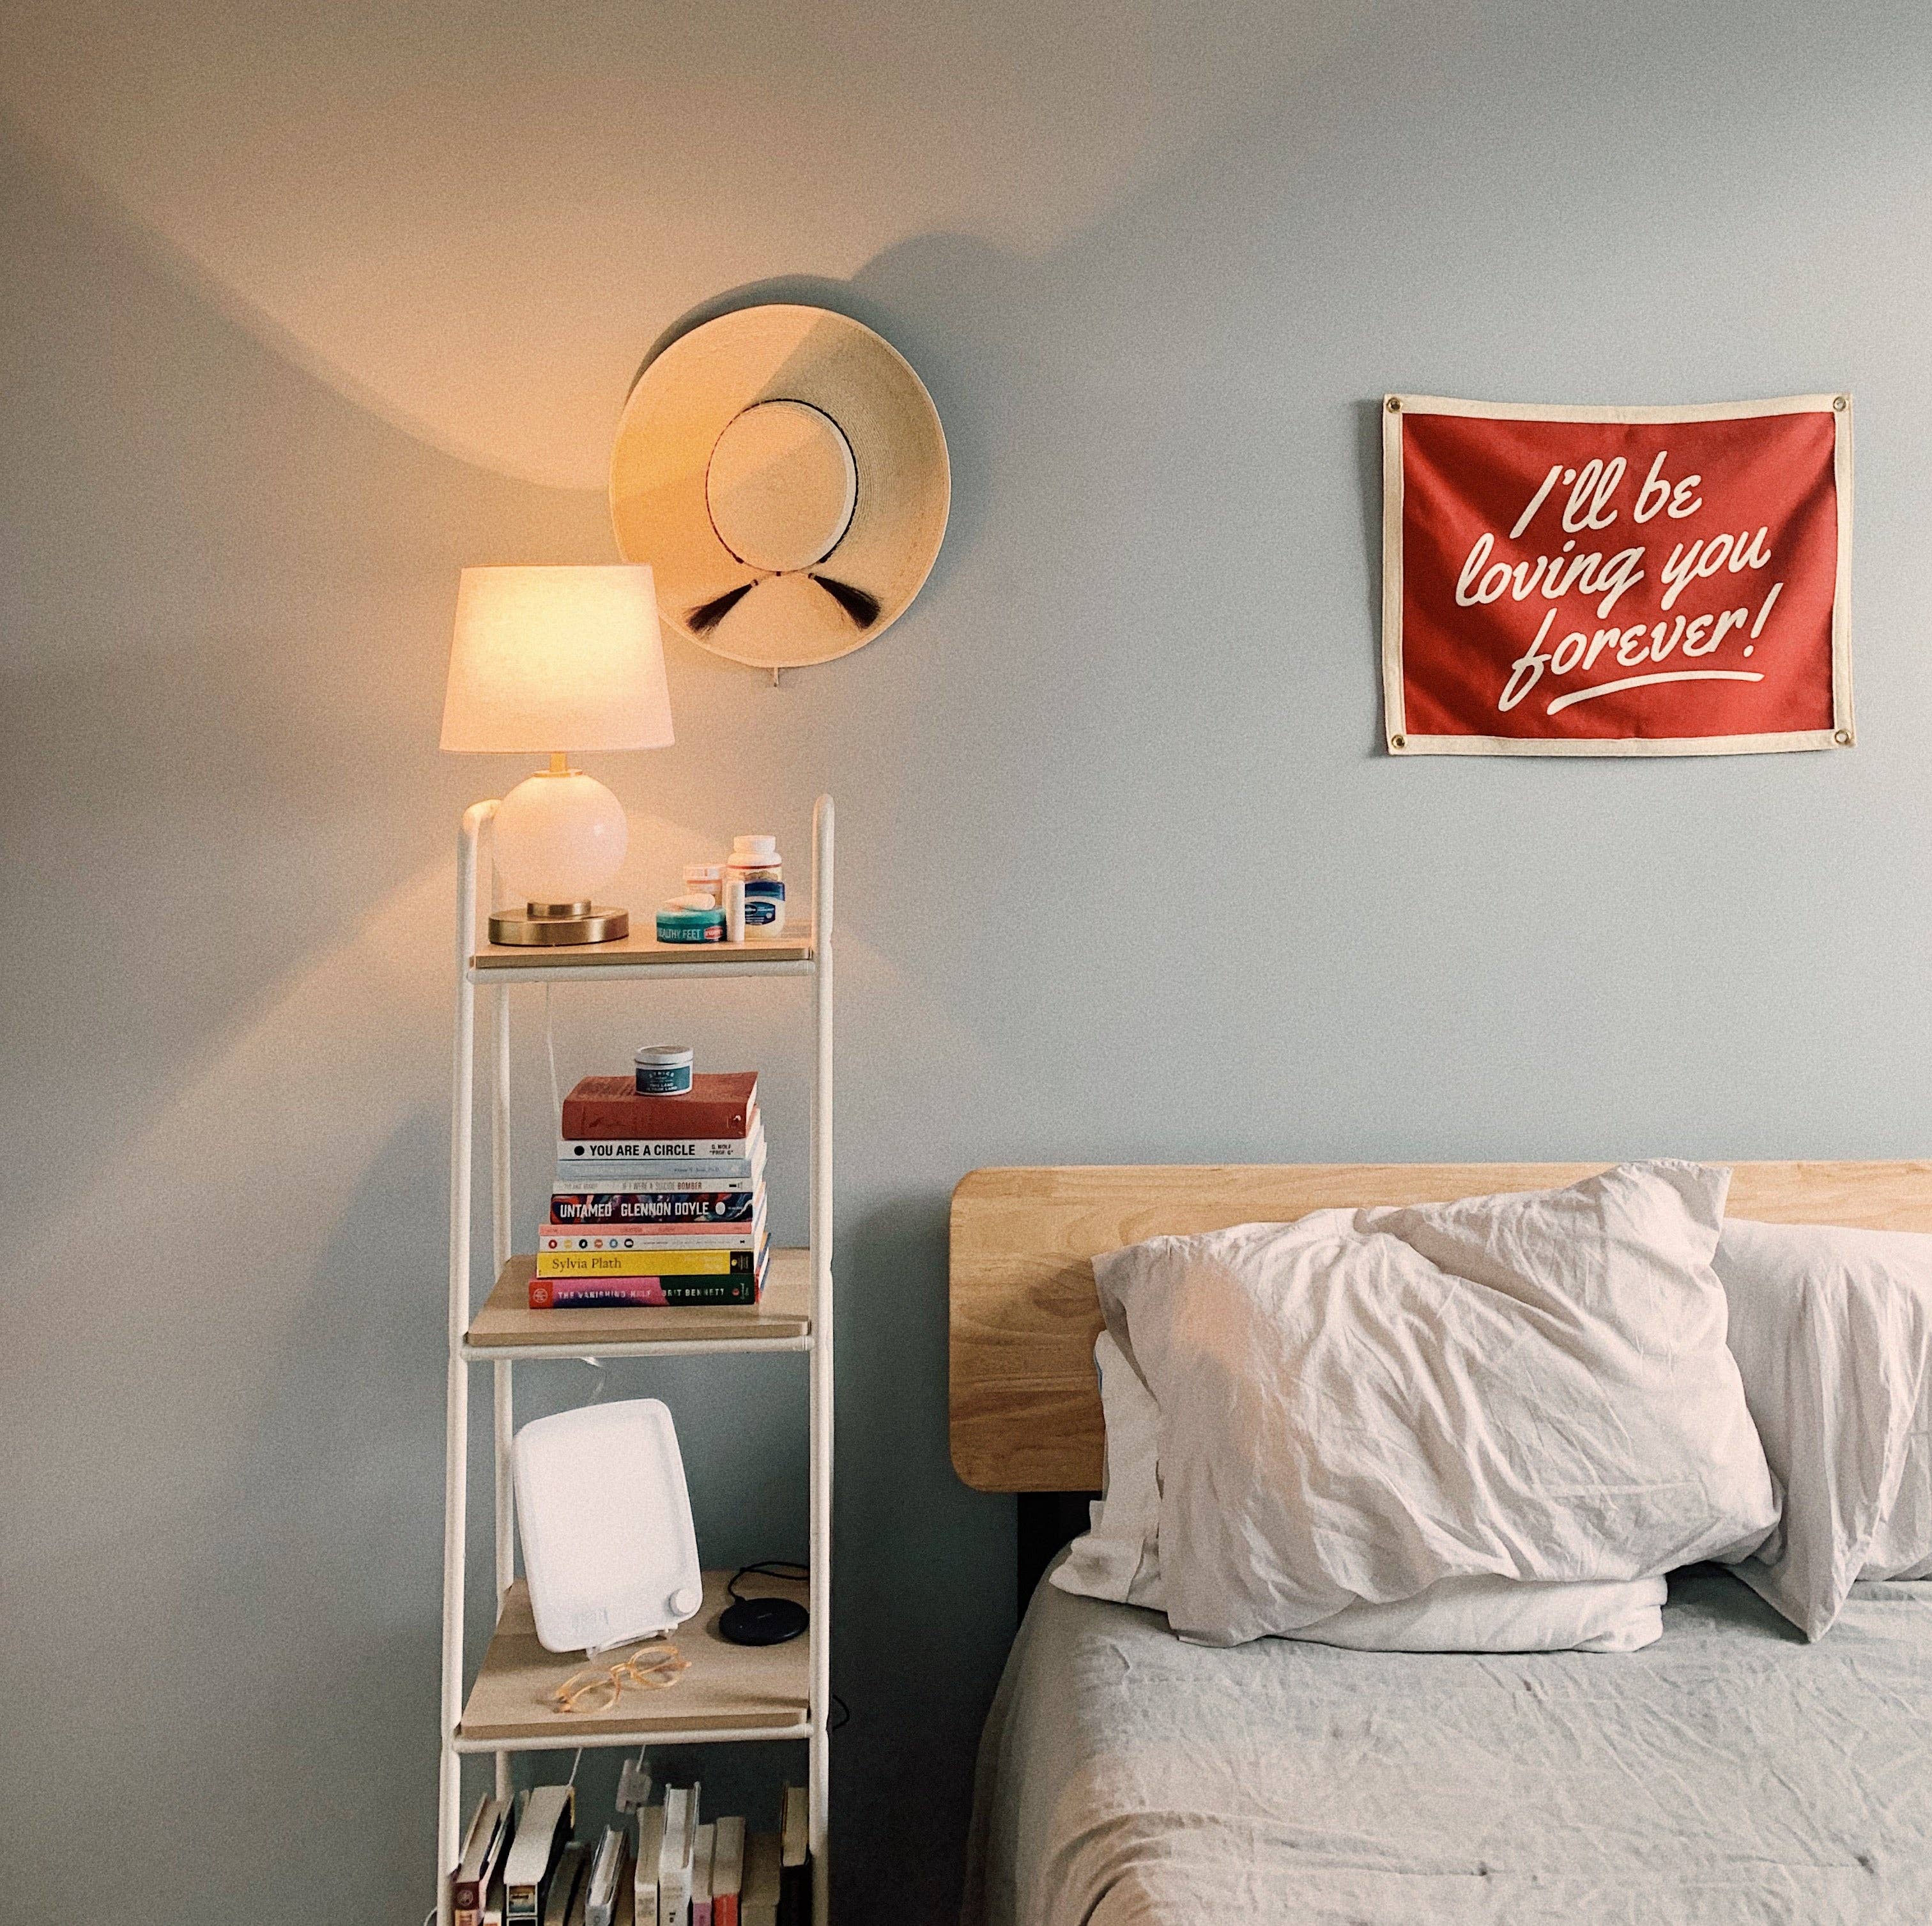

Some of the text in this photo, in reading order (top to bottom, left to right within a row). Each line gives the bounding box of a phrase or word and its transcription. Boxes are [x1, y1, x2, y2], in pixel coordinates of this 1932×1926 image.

[1510, 450, 1703, 539] I'll be
[1455, 526, 1772, 619] loving you
[1498, 582, 1784, 713] forever!
[682, 929, 701, 939] FEET
[590, 1144, 696, 1156] YOU ARE A CIRCLE
[677, 1182, 702, 1190] BOMBER
[560, 1202, 710, 1218] UNTAMED GLENNON DOYLE
[552, 1257, 622, 1273] Sylvia Plath
[685, 1288, 724, 1297] BENNETT
